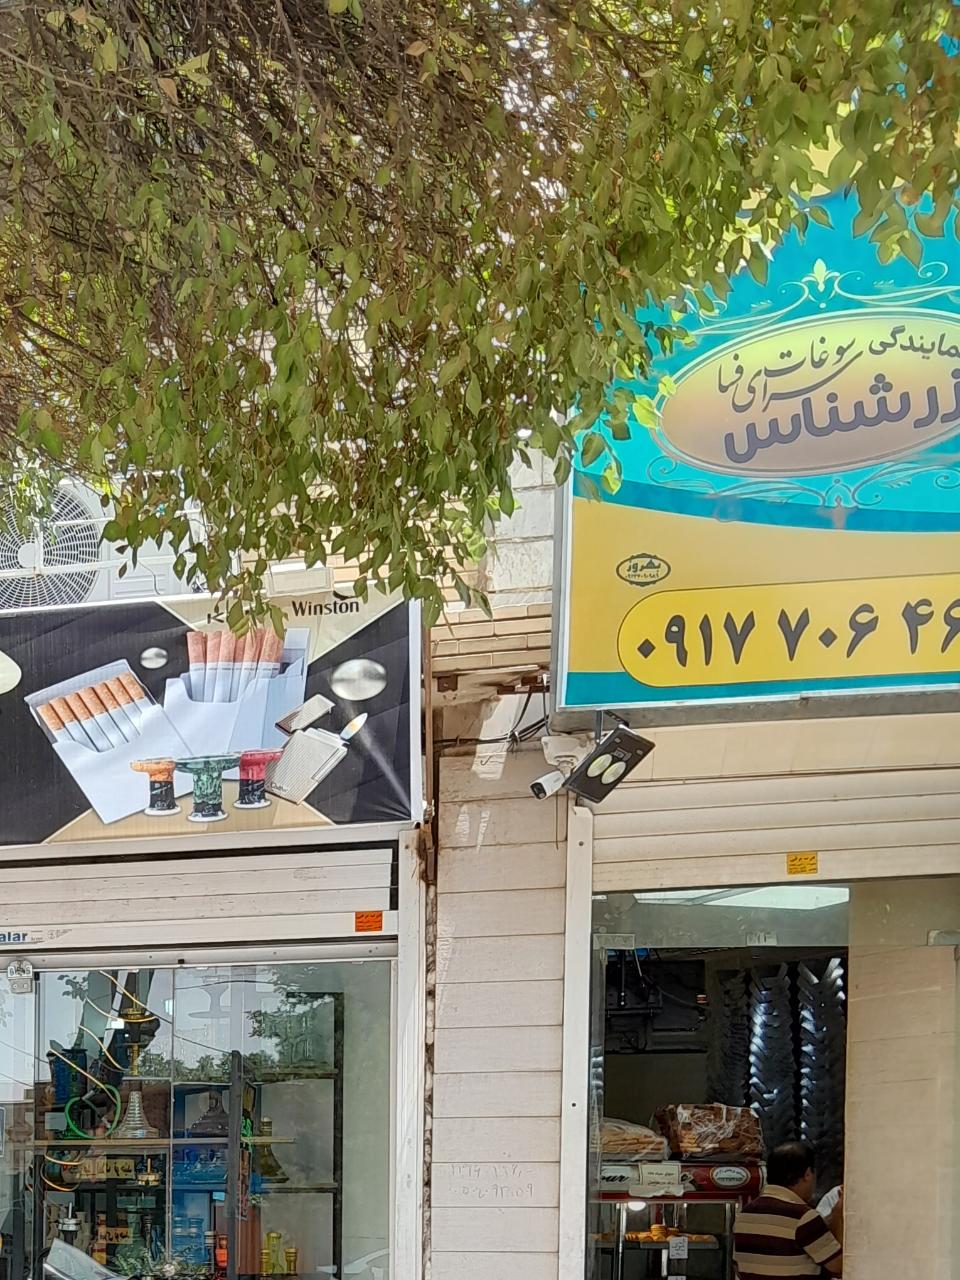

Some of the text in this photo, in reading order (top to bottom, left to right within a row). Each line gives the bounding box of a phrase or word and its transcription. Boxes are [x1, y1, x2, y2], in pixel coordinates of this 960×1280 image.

[869, 325, 960, 360] مایندگی
[291, 600, 360, 617] Winston
[637, 610, 756, 667] ۰۹۱۷
[777, 602, 879, 661] ۷۰۶
